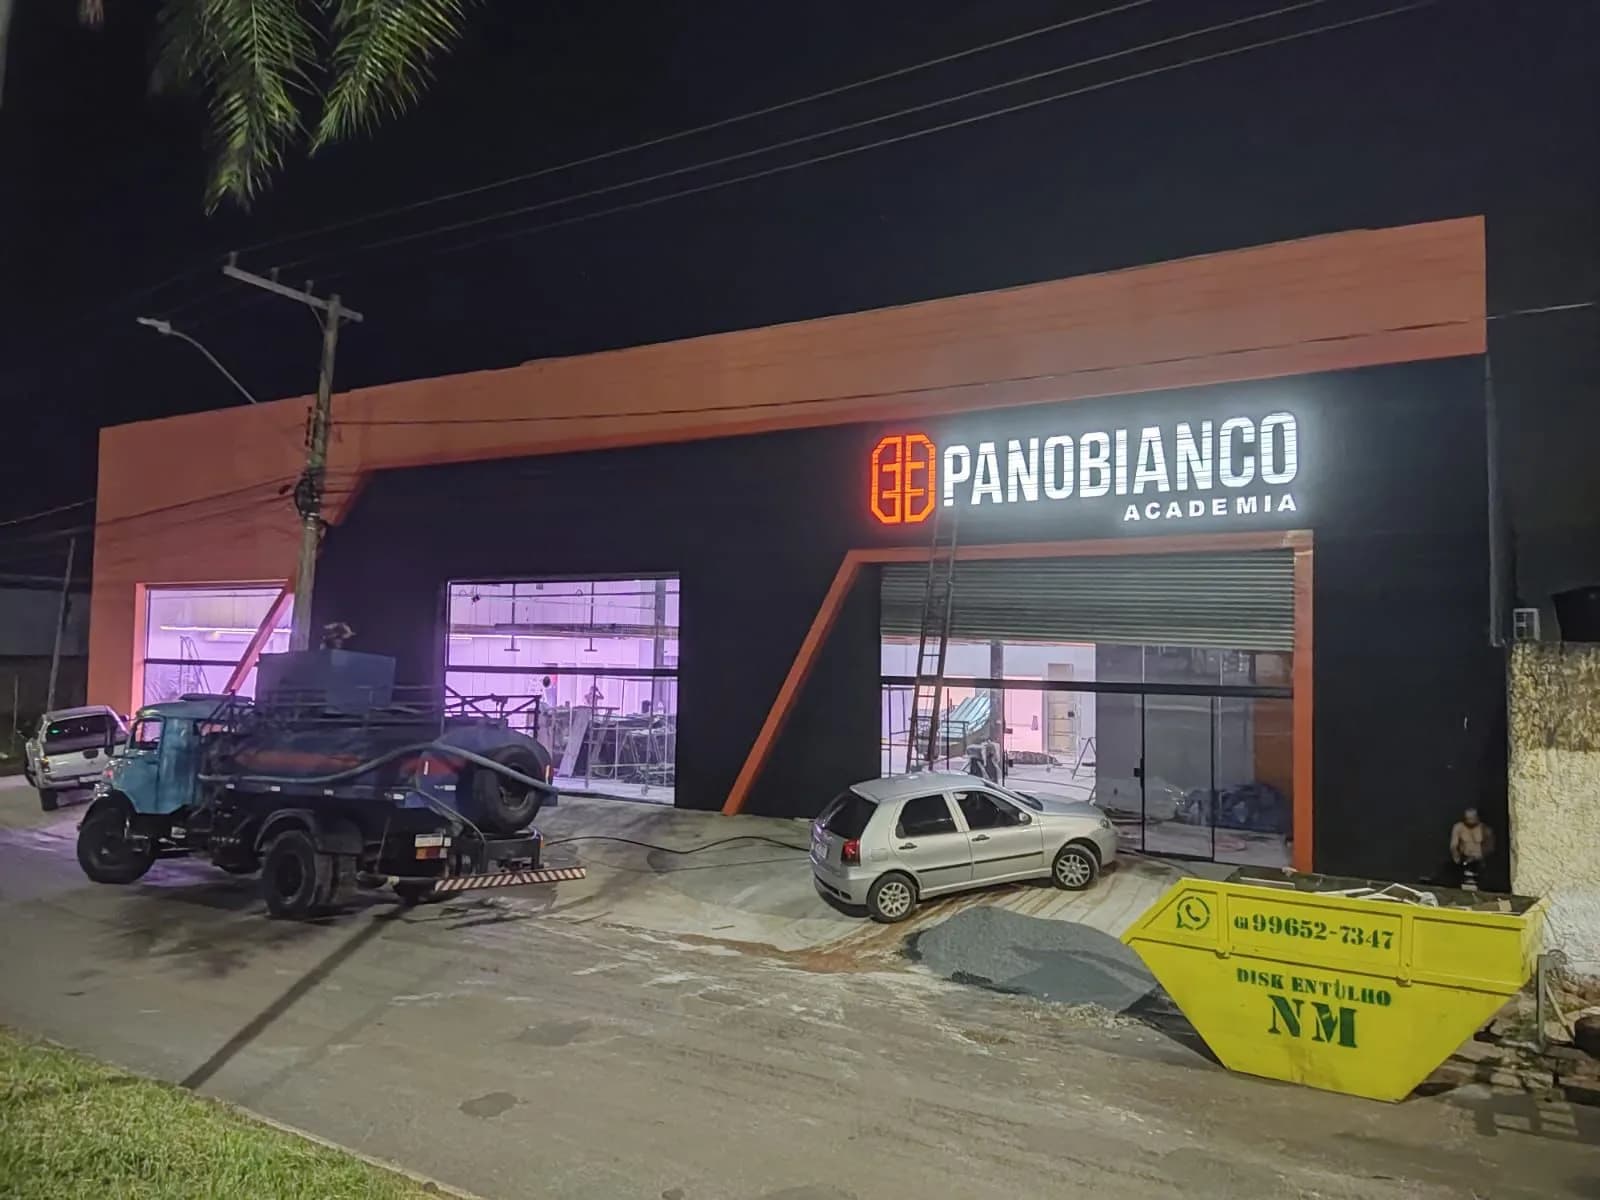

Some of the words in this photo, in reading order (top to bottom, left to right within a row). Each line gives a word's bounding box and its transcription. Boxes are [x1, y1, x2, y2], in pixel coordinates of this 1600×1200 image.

[943, 412, 1298, 507] PANOBIANCO
[1123, 493, 1297, 521] ACADEMIA
[1236, 967, 1284, 990] DISK
[1292, 976, 1393, 1007] ENTULHO
[1267, 994, 1358, 1049] NM
